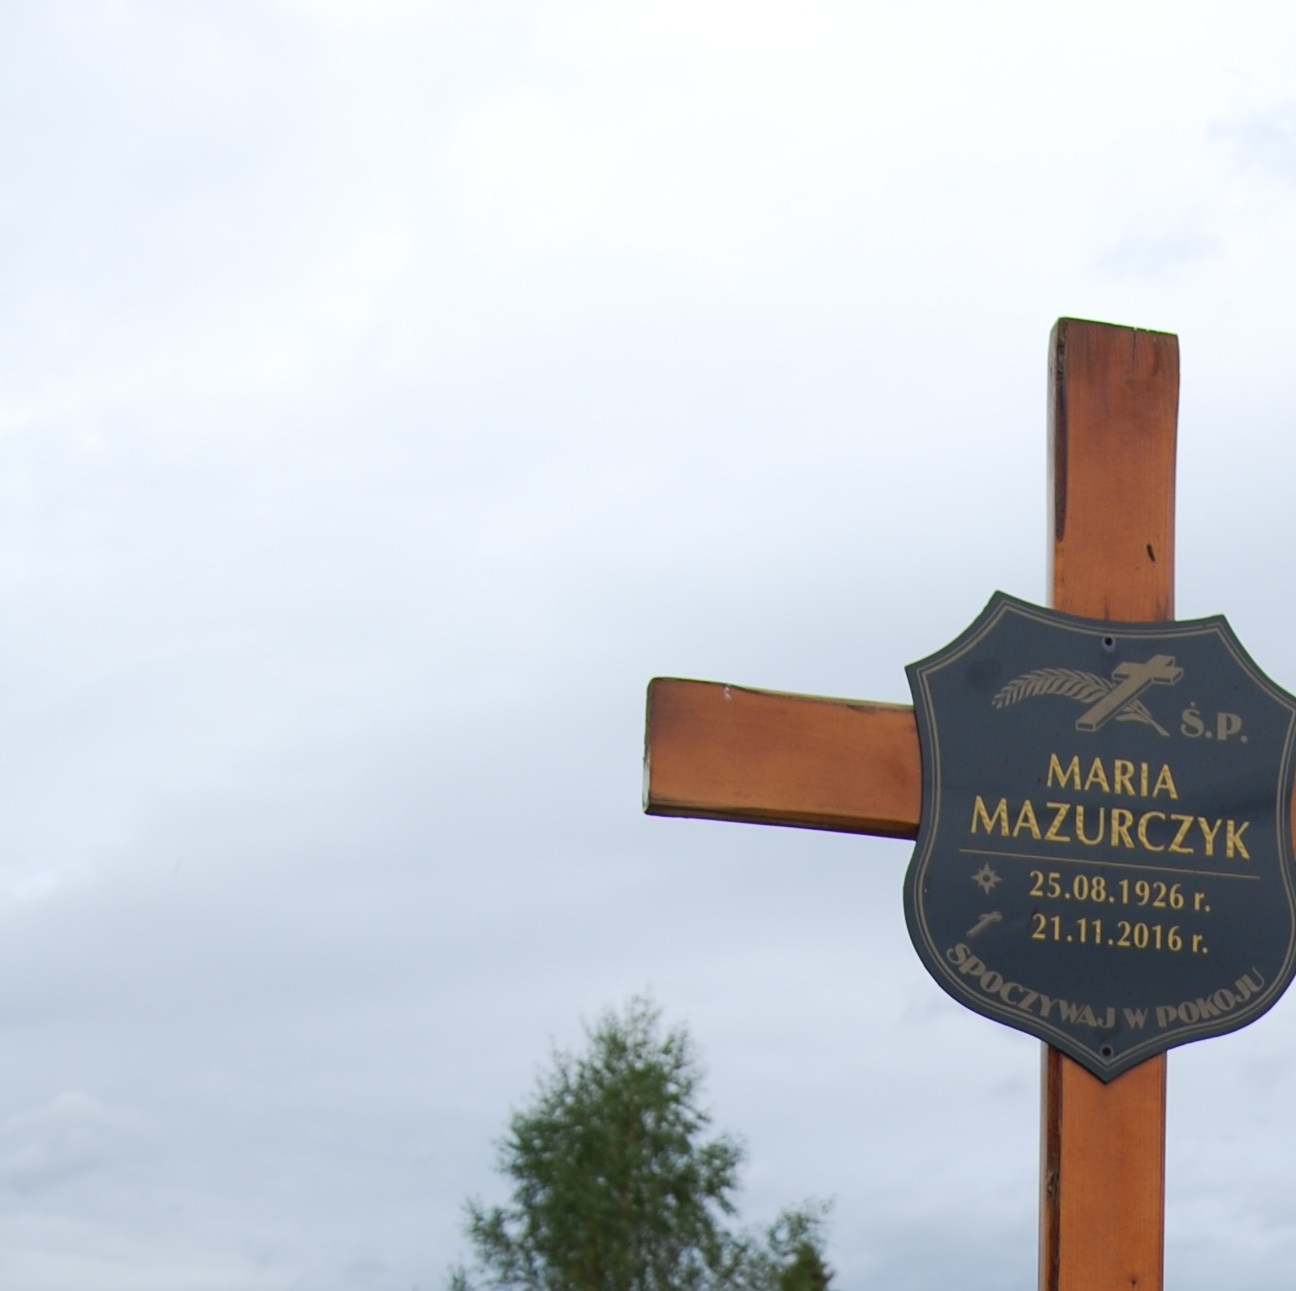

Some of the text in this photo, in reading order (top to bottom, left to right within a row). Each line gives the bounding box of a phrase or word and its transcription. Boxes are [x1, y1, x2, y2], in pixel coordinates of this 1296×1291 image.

[1180, 701, 1248, 742] Ś.P.
[1047, 753, 1178, 800] MARIA
[970, 795, 1250, 859] MAZURCZYK
[1029, 870, 1211, 913] 25.08.1926 r.
[1032, 913, 1208, 954] 21.11.2016 r.
[947, 943, 1266, 1029] SPOCZYWAJ W POKOJU
